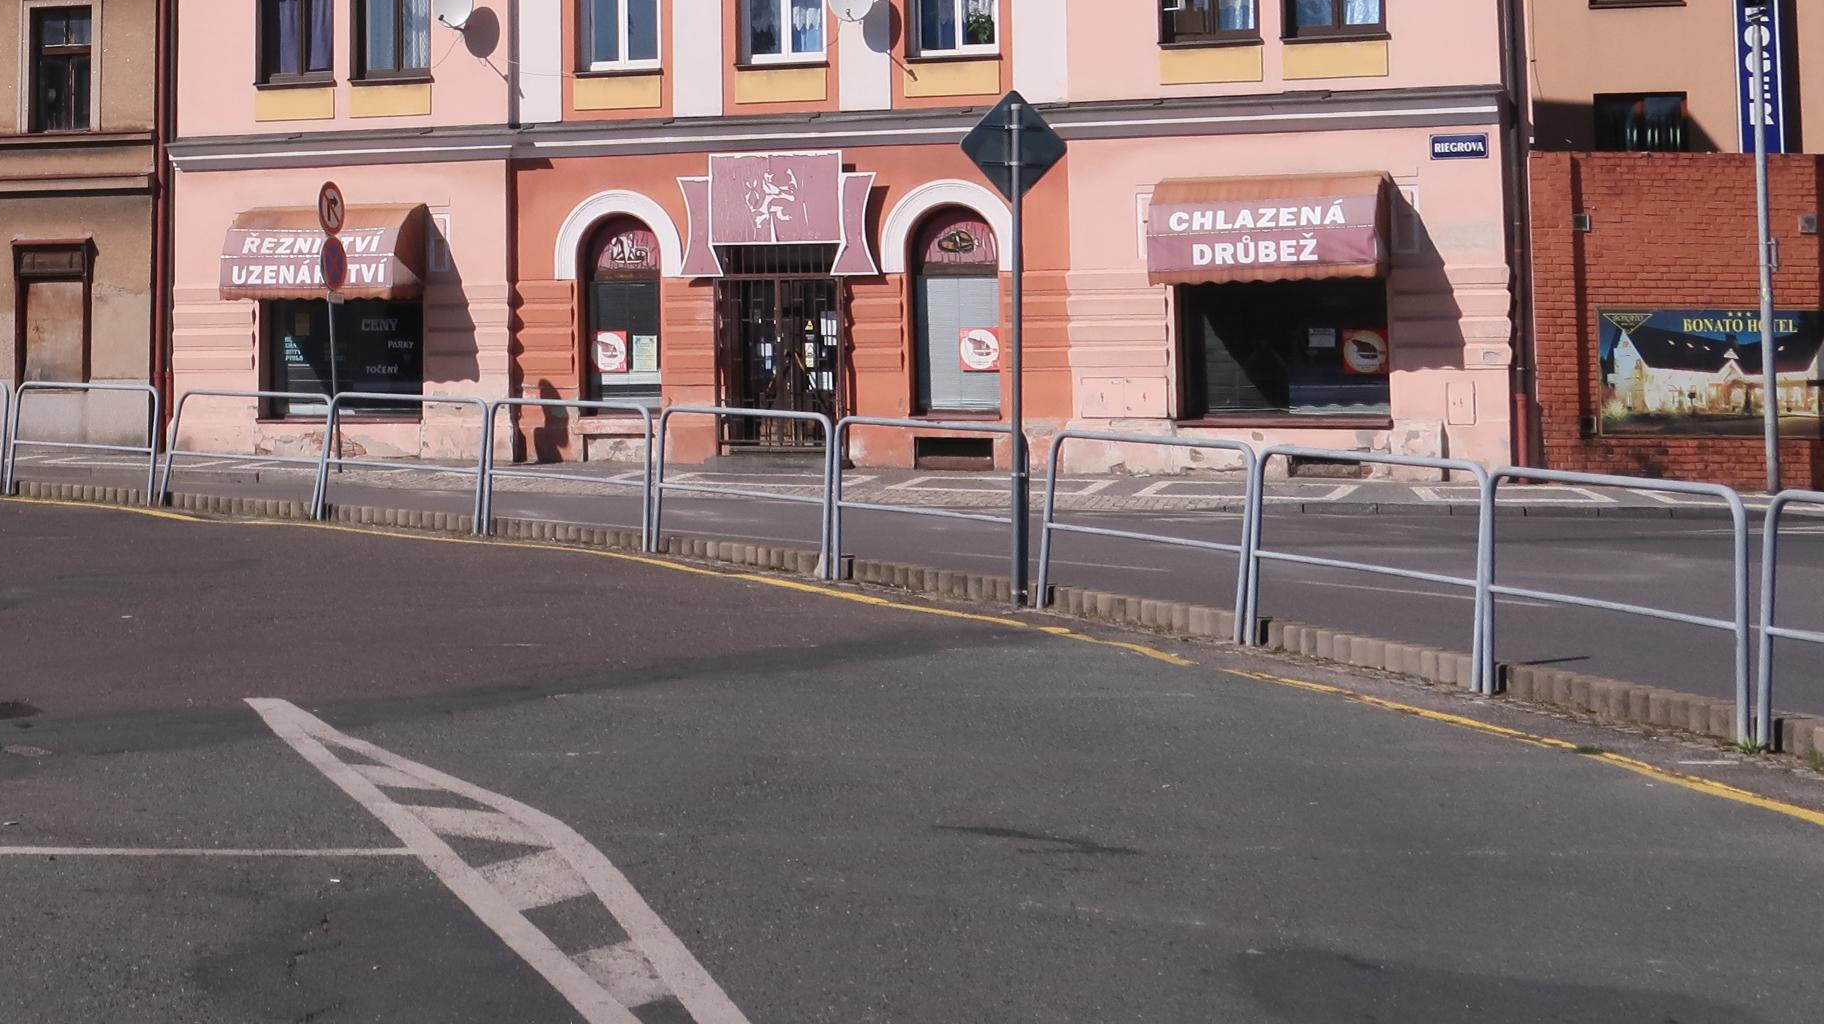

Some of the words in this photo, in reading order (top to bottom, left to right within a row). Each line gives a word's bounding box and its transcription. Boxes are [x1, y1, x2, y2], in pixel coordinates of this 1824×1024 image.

[1434, 141, 1484, 154] RIEGROVA
[1169, 199, 1346, 232] CHLAZENÁ
[242, 230, 384, 254] ŘEZNITVÍ
[1192, 232, 1319, 266] DRŮBEŽ
[232, 258, 387, 285] UZENÁTVÍ
[361, 318, 398, 332] CENY
[1683, 318, 1743, 333] BONATO
[387, 338, 415, 350] PÁRKY
[365, 363, 399, 375] TOČENÝ
